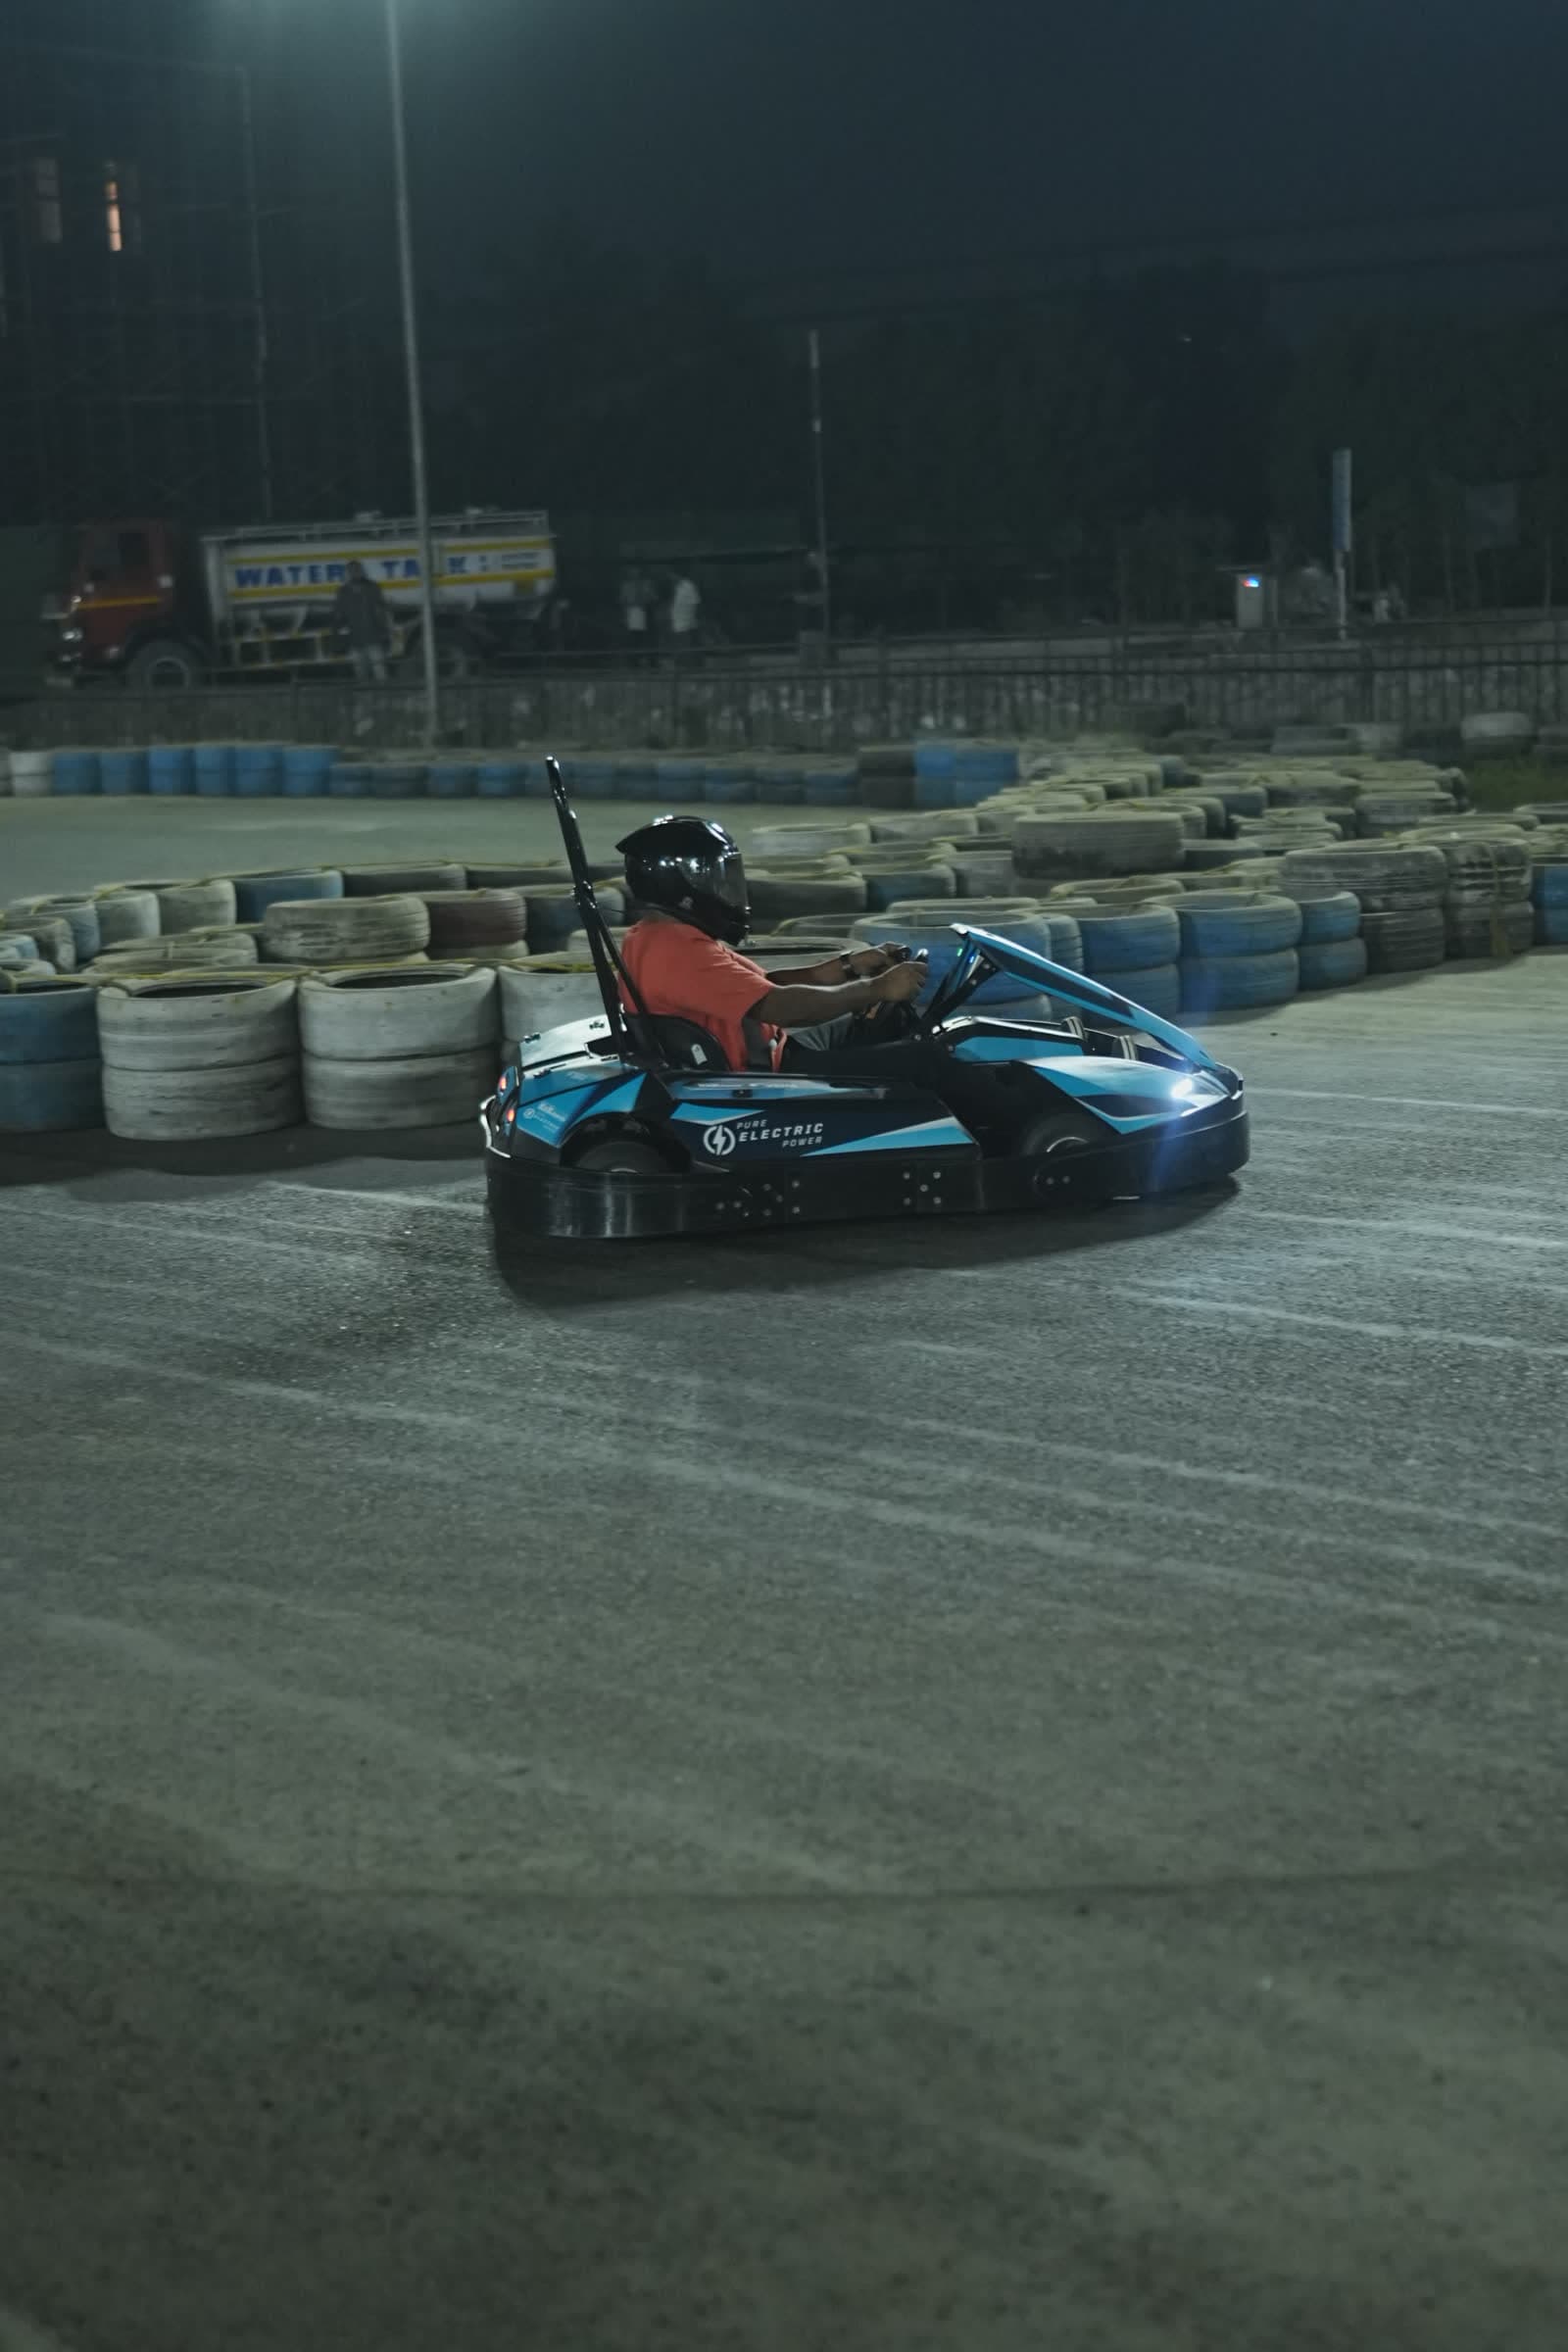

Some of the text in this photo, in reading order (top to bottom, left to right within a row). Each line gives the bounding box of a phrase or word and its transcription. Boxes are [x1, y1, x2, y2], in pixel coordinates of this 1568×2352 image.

[234, 563, 346, 587] WATER
[381, 556, 466, 578] TAK
[736, 1119, 768, 1130] PURE
[738, 1123, 824, 1143] ELECTRIC
[782, 1136, 823, 1148] POWER
